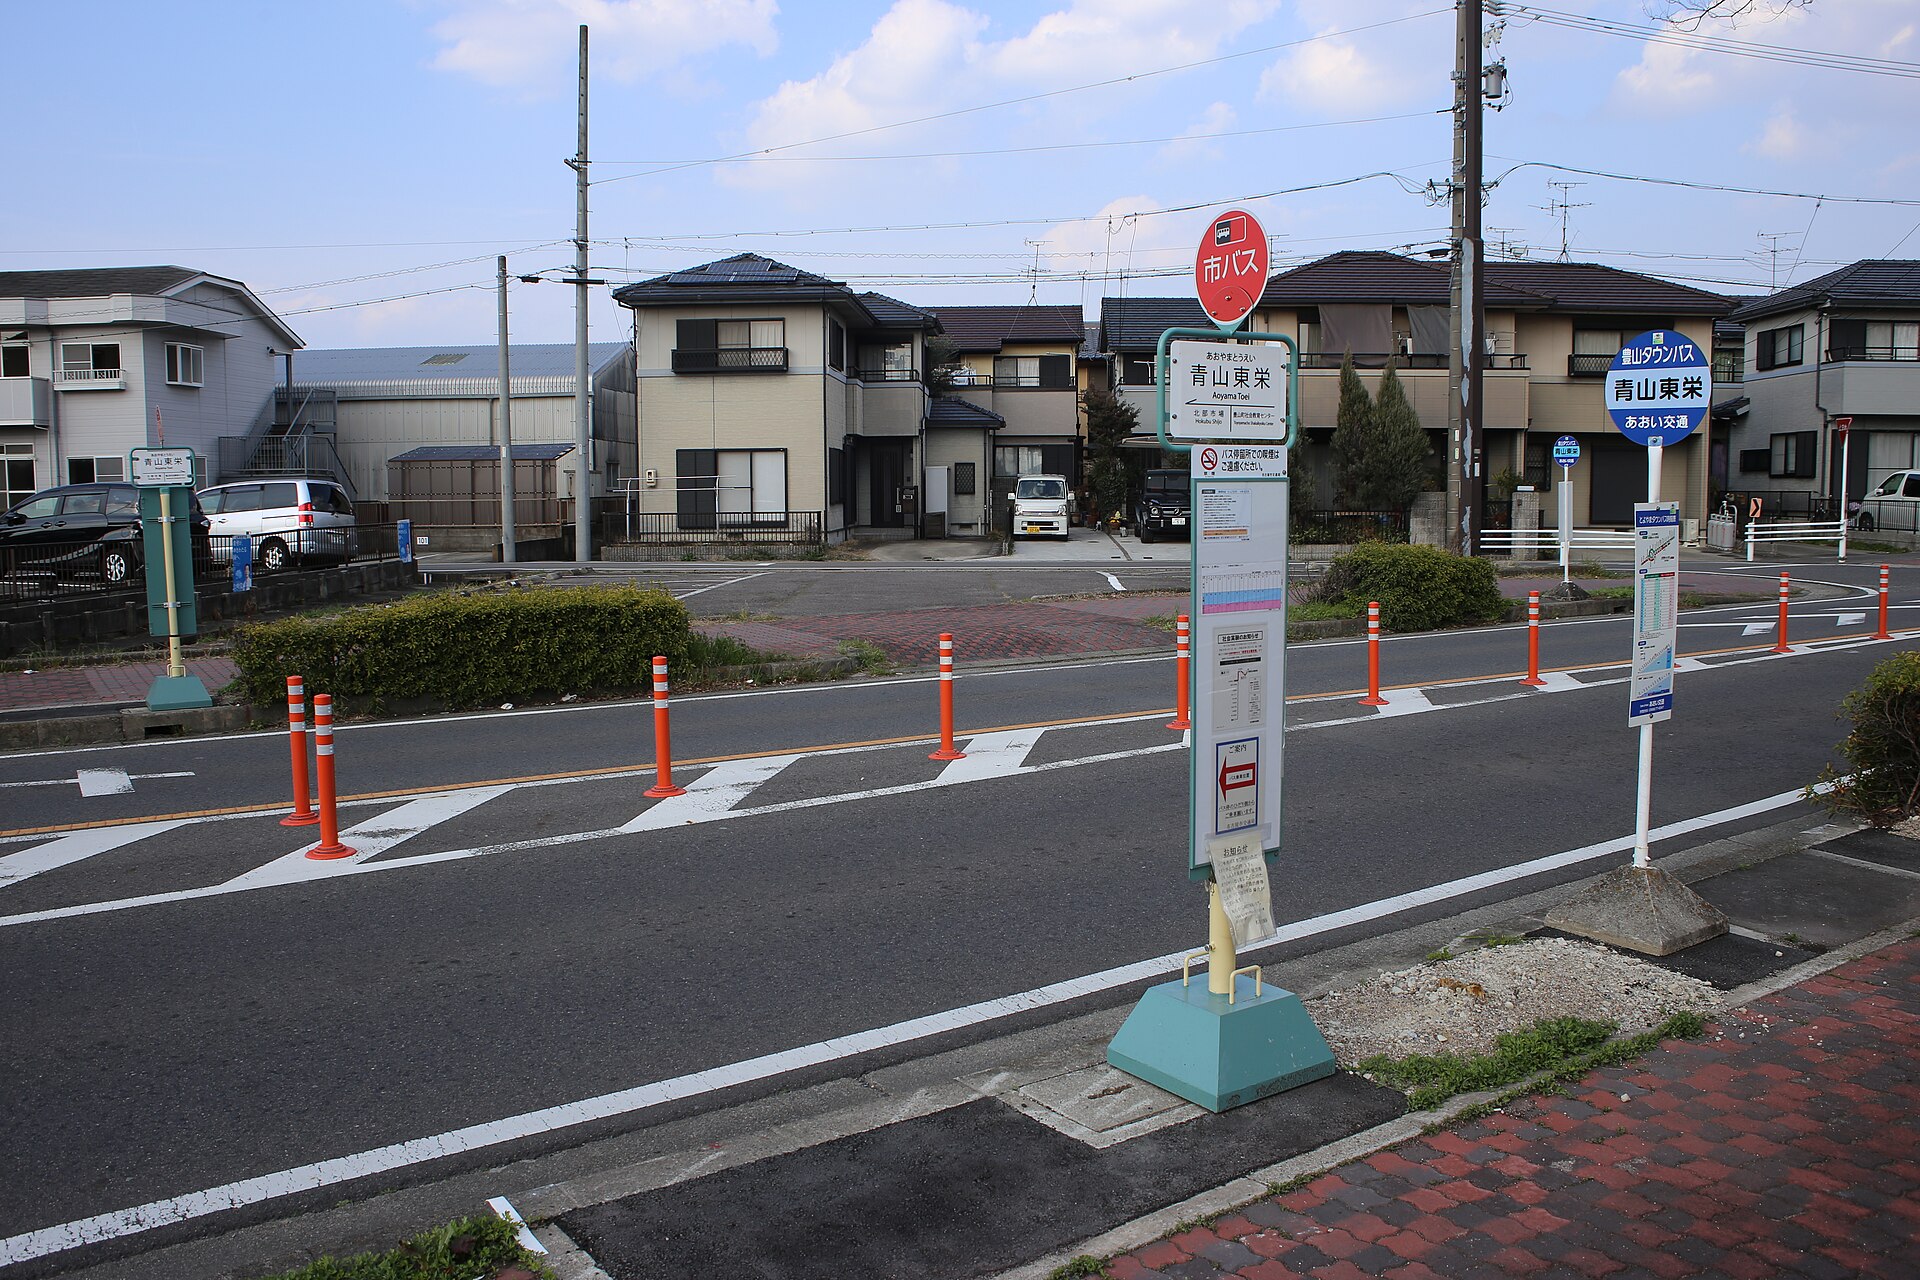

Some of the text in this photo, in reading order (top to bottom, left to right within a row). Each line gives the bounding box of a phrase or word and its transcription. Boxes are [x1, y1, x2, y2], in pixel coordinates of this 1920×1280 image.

[1203, 249, 1259, 283] 市バス
[1206, 352, 1256, 363] あおやまとうえい
[1621, 344, 1695, 366] 豊山タウンバス
[1190, 363, 1271, 389] 青山東栄
[1614, 376, 1703, 402] 青山東栄
[1212, 391, 1250, 401] Aoyama Toei
[1193, 410, 1224, 418] 北部市場
[1625, 414, 1689, 429] あおい交通
[1221, 448, 1280, 460] バス停留所での喫煙は
[1221, 461, 1263, 472] ご遠慮ください。
[1228, 744, 1247, 754] ご案内
[1223, 845, 1249, 857] お知らせ
